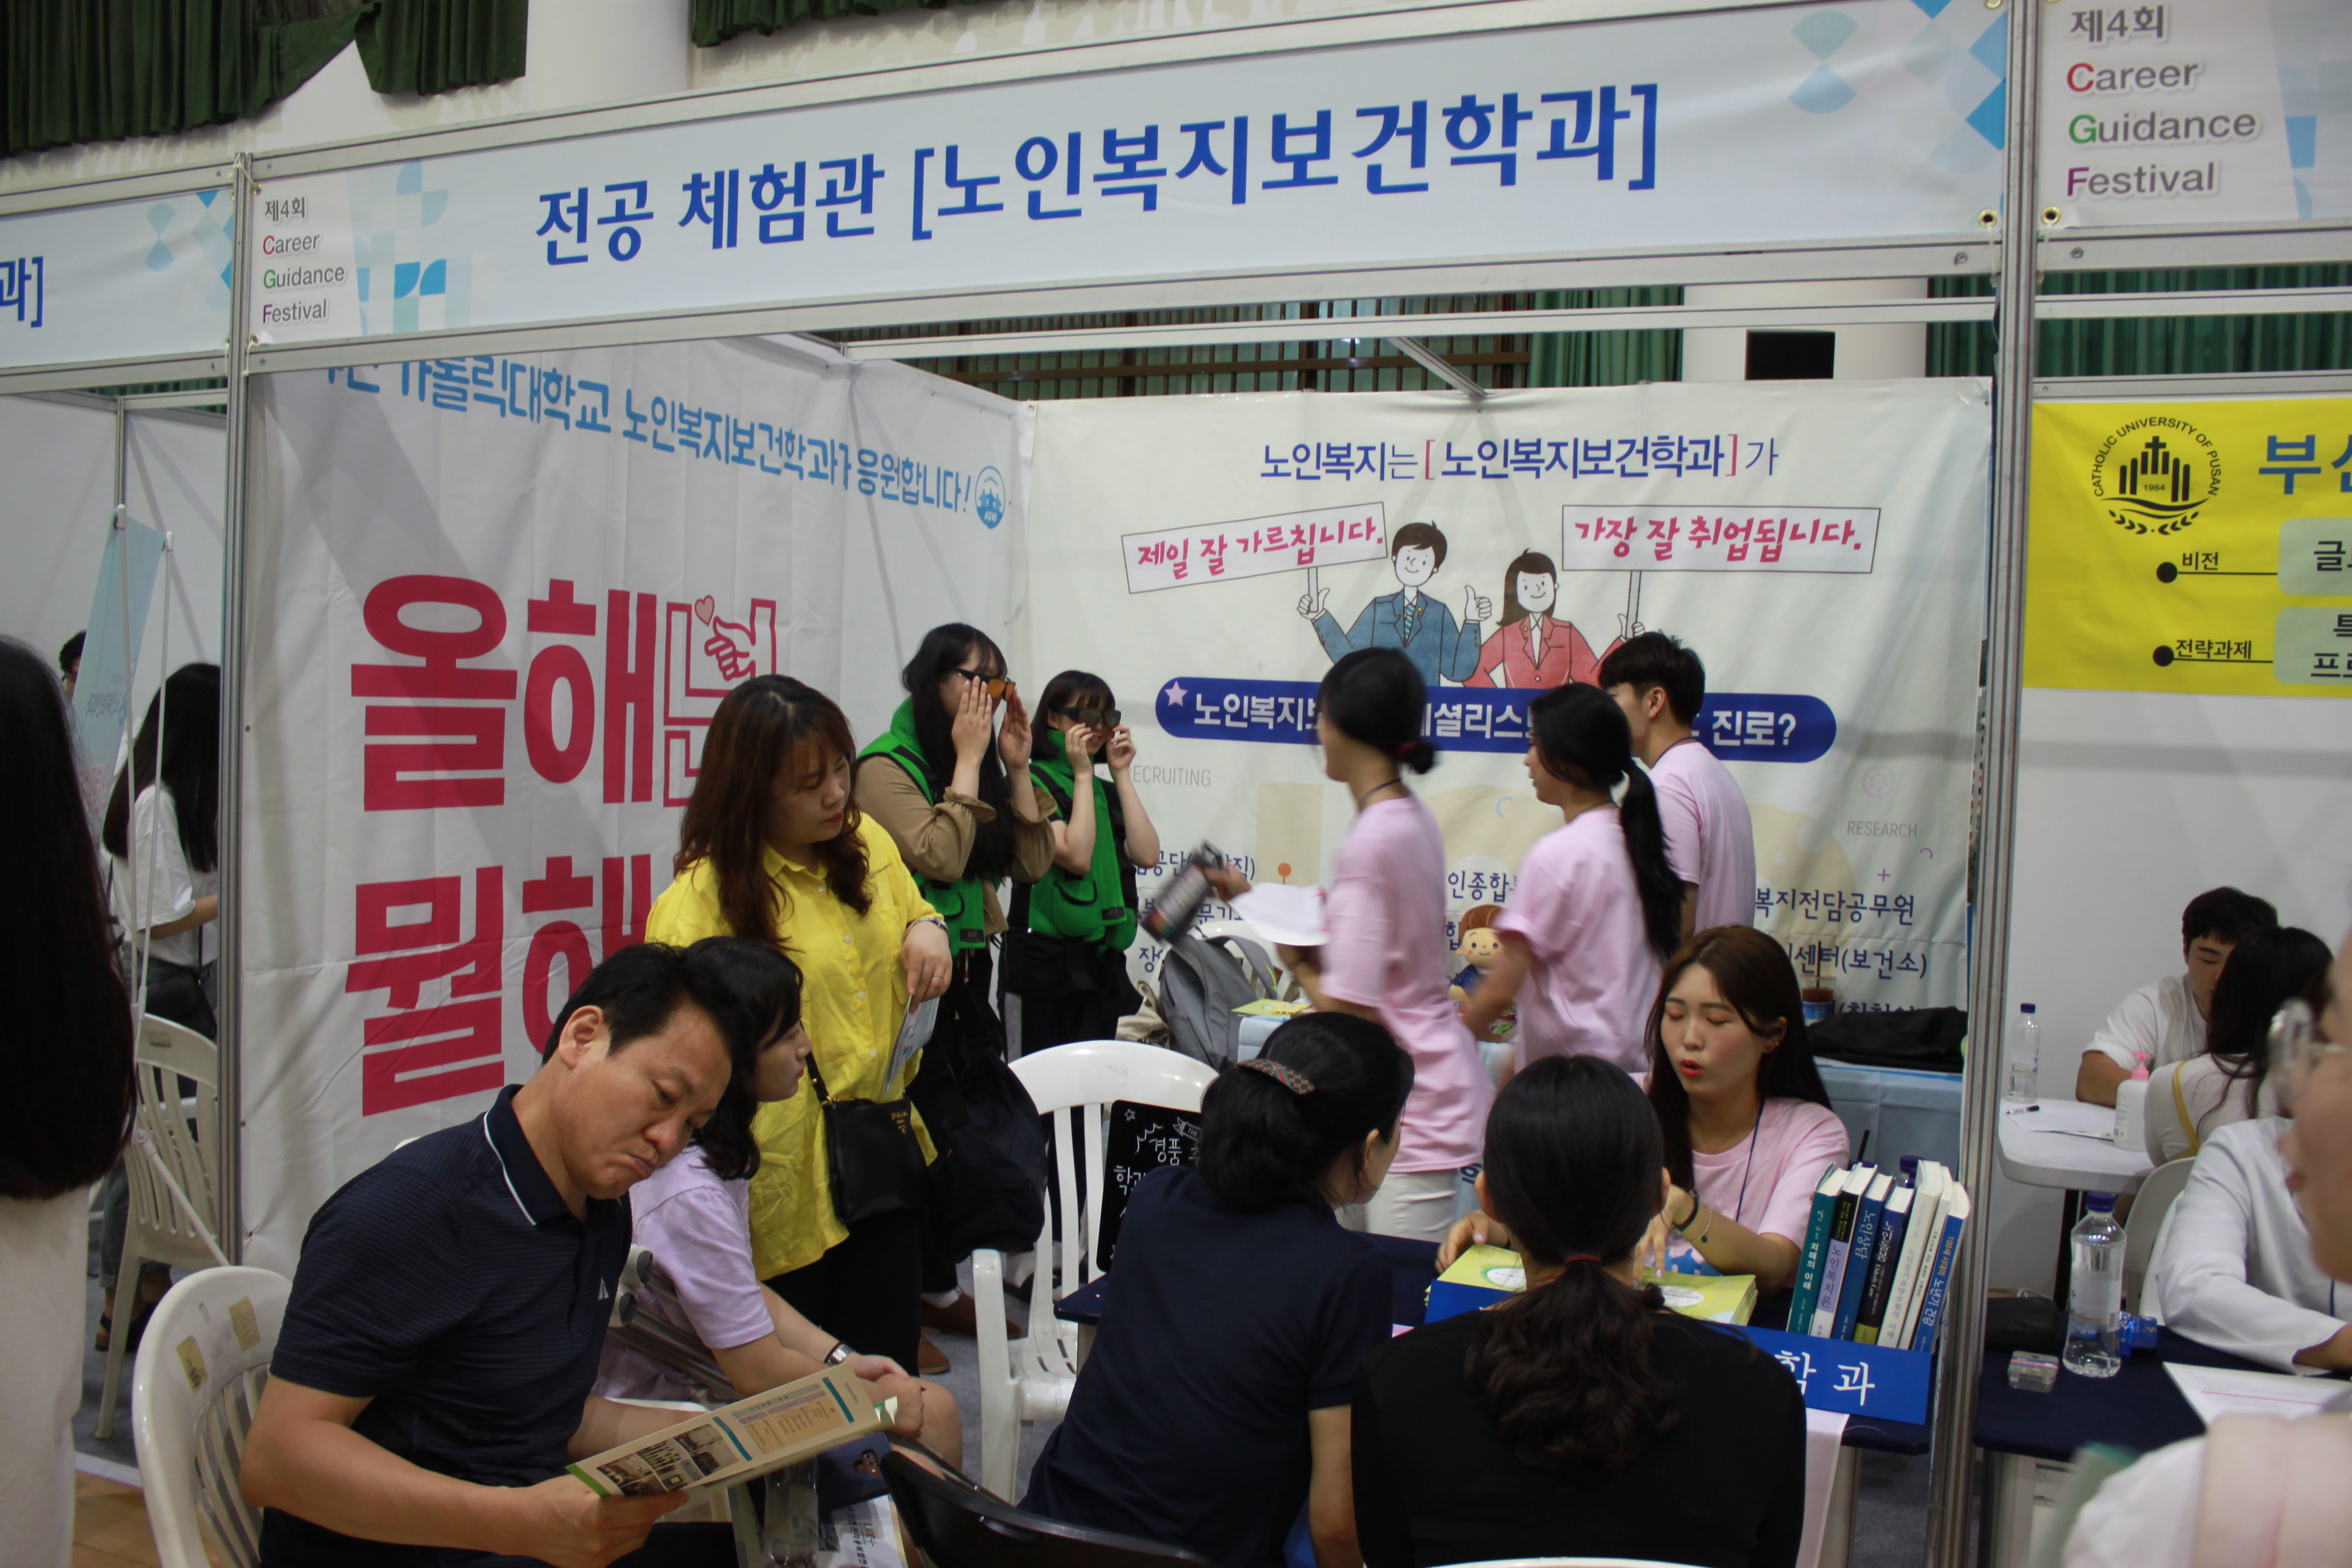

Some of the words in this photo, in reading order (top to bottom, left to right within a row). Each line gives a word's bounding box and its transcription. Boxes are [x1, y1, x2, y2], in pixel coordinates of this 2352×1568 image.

[2070, 5, 2164, 42] 제4회
[2067, 62, 2198, 92] Career
[2068, 111, 2256, 144] Guidance
[536, 180, 654, 266] 전공
[678, 153, 885, 250] 체험관
[912, 82, 1658, 242] [노인복지보건학과]
[2067, 161, 2215, 197] Festival
[264, 196, 306, 222] 제4회
[263, 233, 320, 255] Career
[263, 265, 345, 290] Guidance
[262, 298, 328, 324] Festival
[1260, 441, 1418, 481] 노인복지는
[2091, 436, 2117, 497] CATHOLIC
[2116, 417, 2197, 438] UNIVERSITY
[2195, 432, 2213, 448] OF
[2206, 449, 2222, 496] PUSAN
[857, 447, 972, 513] 응원합니다!
[1137, 538, 1189, 580] 제일
[1200, 534, 1228, 577] 잘
[1236, 516, 1384, 566] 가르칩니다.
[1574, 516, 1638, 558] 가장
[1646, 516, 1680, 561] 잘
[1688, 515, 1862, 563] 취업됩니다.
[2181, 552, 2219, 571] 비전
[2175, 638, 2253, 660] 전략과제
[1712, 711, 1797, 746] 진로?
[1847, 820, 1917, 838] RESEARCH
[1149, 1137, 1182, 1166] 경품
[1855, 1210, 1876, 1260] 노인상담
[1943, 1236, 1955, 1256] 100세
[1807, 1242, 1819, 1269] 치매의
[1937, 1256, 1950, 1276] 시대의
[1803, 1273, 1813, 1290] 이해
[1928, 1277, 1944, 1307] 노년기
[1922, 1308, 1937, 1327] 건강
